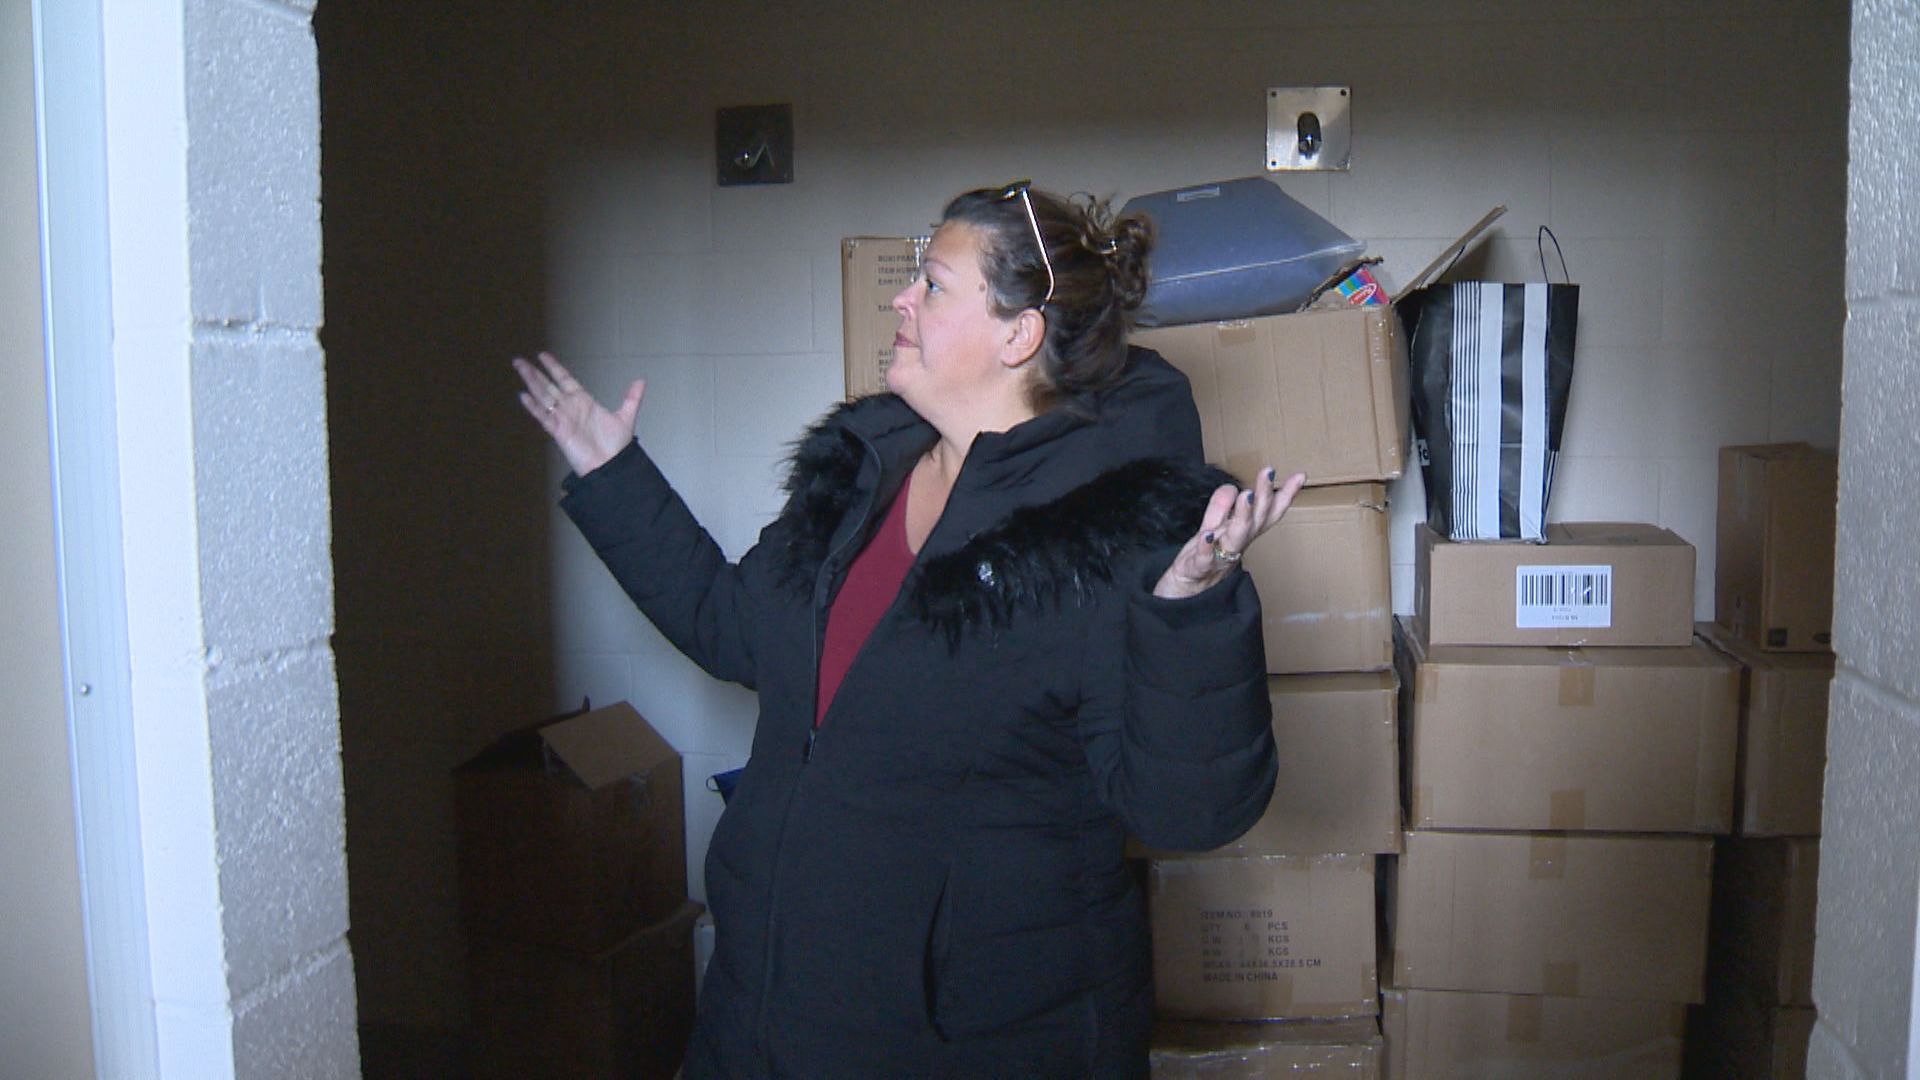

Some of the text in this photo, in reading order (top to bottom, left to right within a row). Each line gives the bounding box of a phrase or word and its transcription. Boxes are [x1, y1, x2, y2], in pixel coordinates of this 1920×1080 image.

[1267, 921, 1289, 930] PCS
[1268, 935, 1290, 943] KGS
[1268, 947, 1289, 956] KGS
[1306, 959, 1321, 967] CM
[1202, 973, 1233, 982] MADE
[1246, 972, 1278, 982] CHINA
